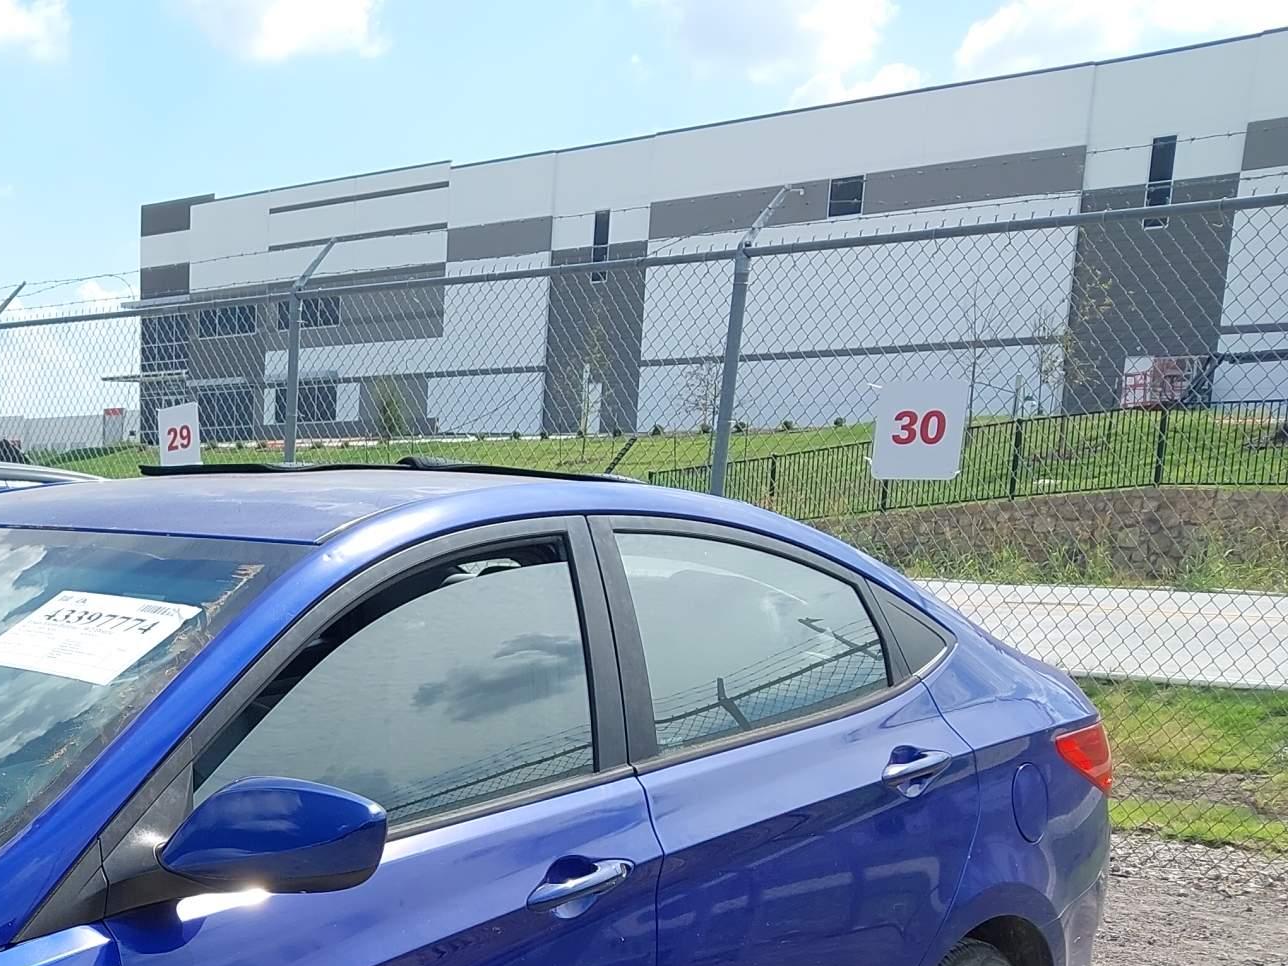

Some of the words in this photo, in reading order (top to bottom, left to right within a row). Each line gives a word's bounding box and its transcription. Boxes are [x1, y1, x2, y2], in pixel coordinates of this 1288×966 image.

[167, 424, 192, 452] 29
[891, 409, 947, 446] 30
[44, 607, 161, 635] 43397774
